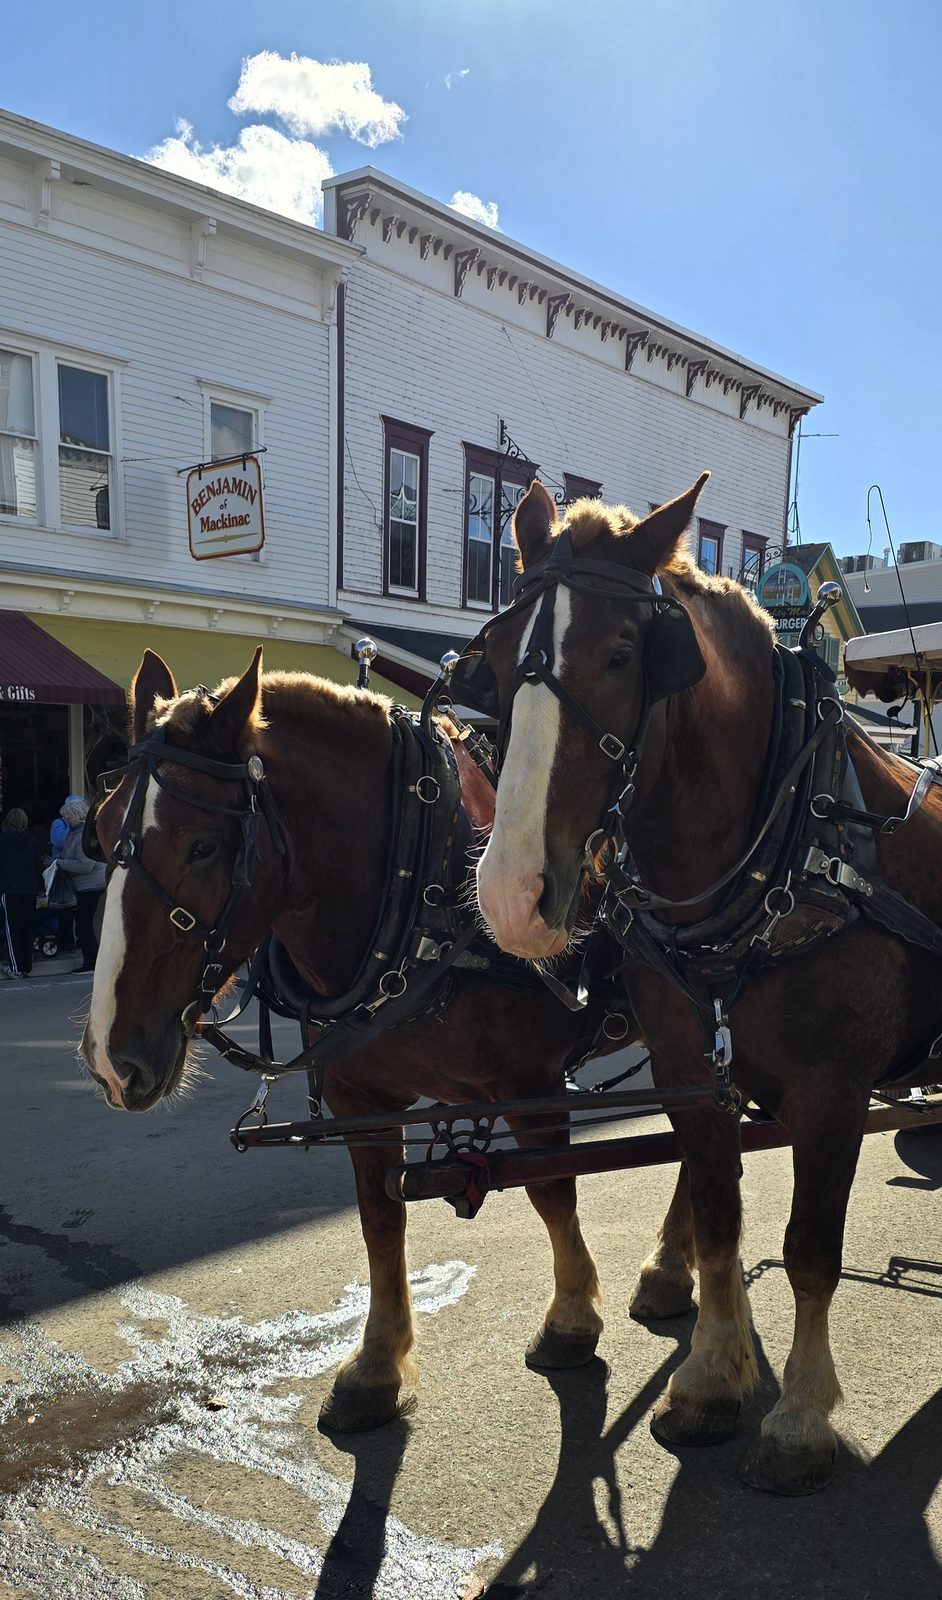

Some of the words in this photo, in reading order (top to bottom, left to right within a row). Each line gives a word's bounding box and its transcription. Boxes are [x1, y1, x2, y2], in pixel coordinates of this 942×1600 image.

[191, 477, 257, 516] BENJAMIN
[220, 499, 228, 510] of
[200, 513, 251, 533] Mackinac
[776, 617, 807, 630] URGER
[7, 685, 35, 700] Gifts
